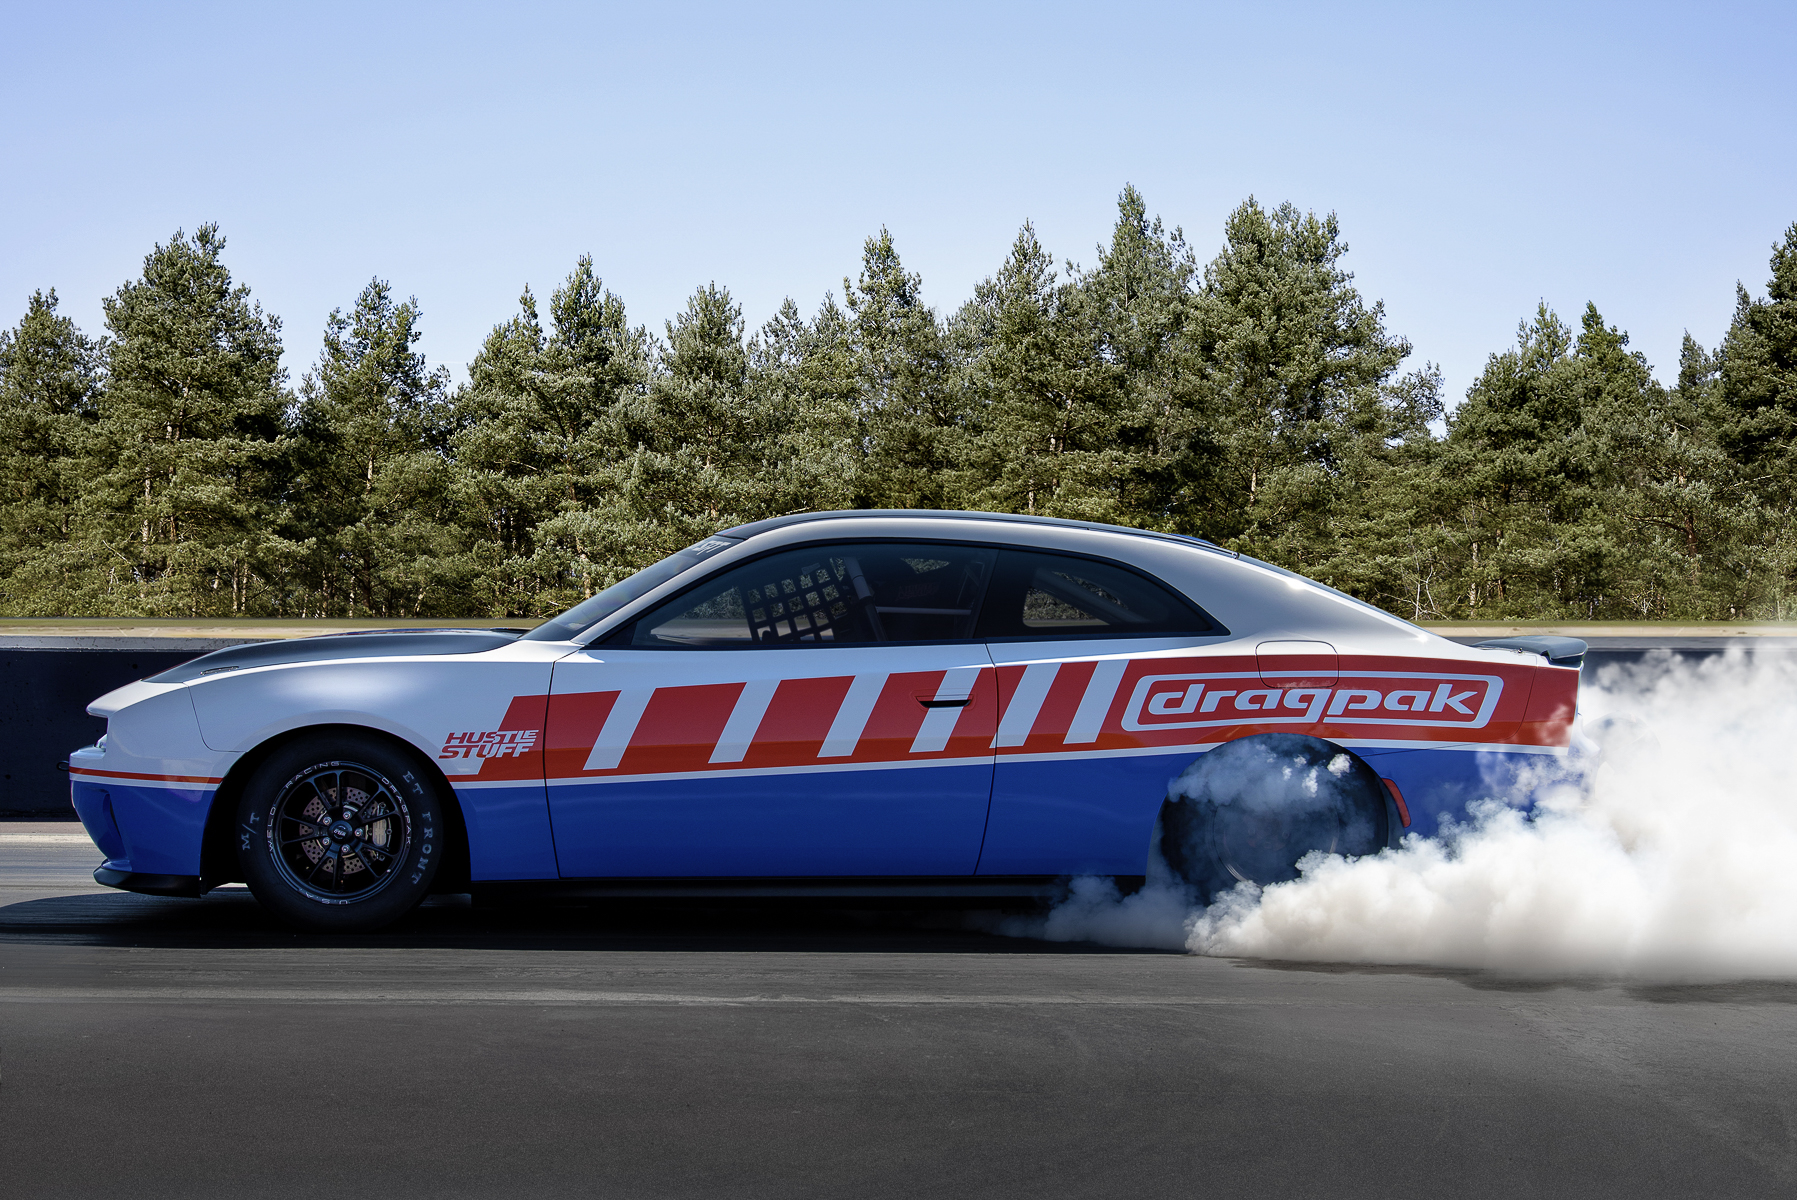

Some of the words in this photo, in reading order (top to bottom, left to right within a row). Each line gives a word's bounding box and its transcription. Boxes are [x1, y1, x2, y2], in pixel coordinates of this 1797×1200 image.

[1148, 683, 1478, 723] dragpak
[438, 743, 533, 759] STUFF
[445, 730, 539, 744] HUSTLE
[402, 771, 424, 796] ET
[266, 806, 277, 852] WELD
[285, 761, 340, 789] RACING
[381, 776, 411, 845] DRAGPAK
[241, 812, 260, 850] M/T
[412, 811, 433, 885] FRONT
